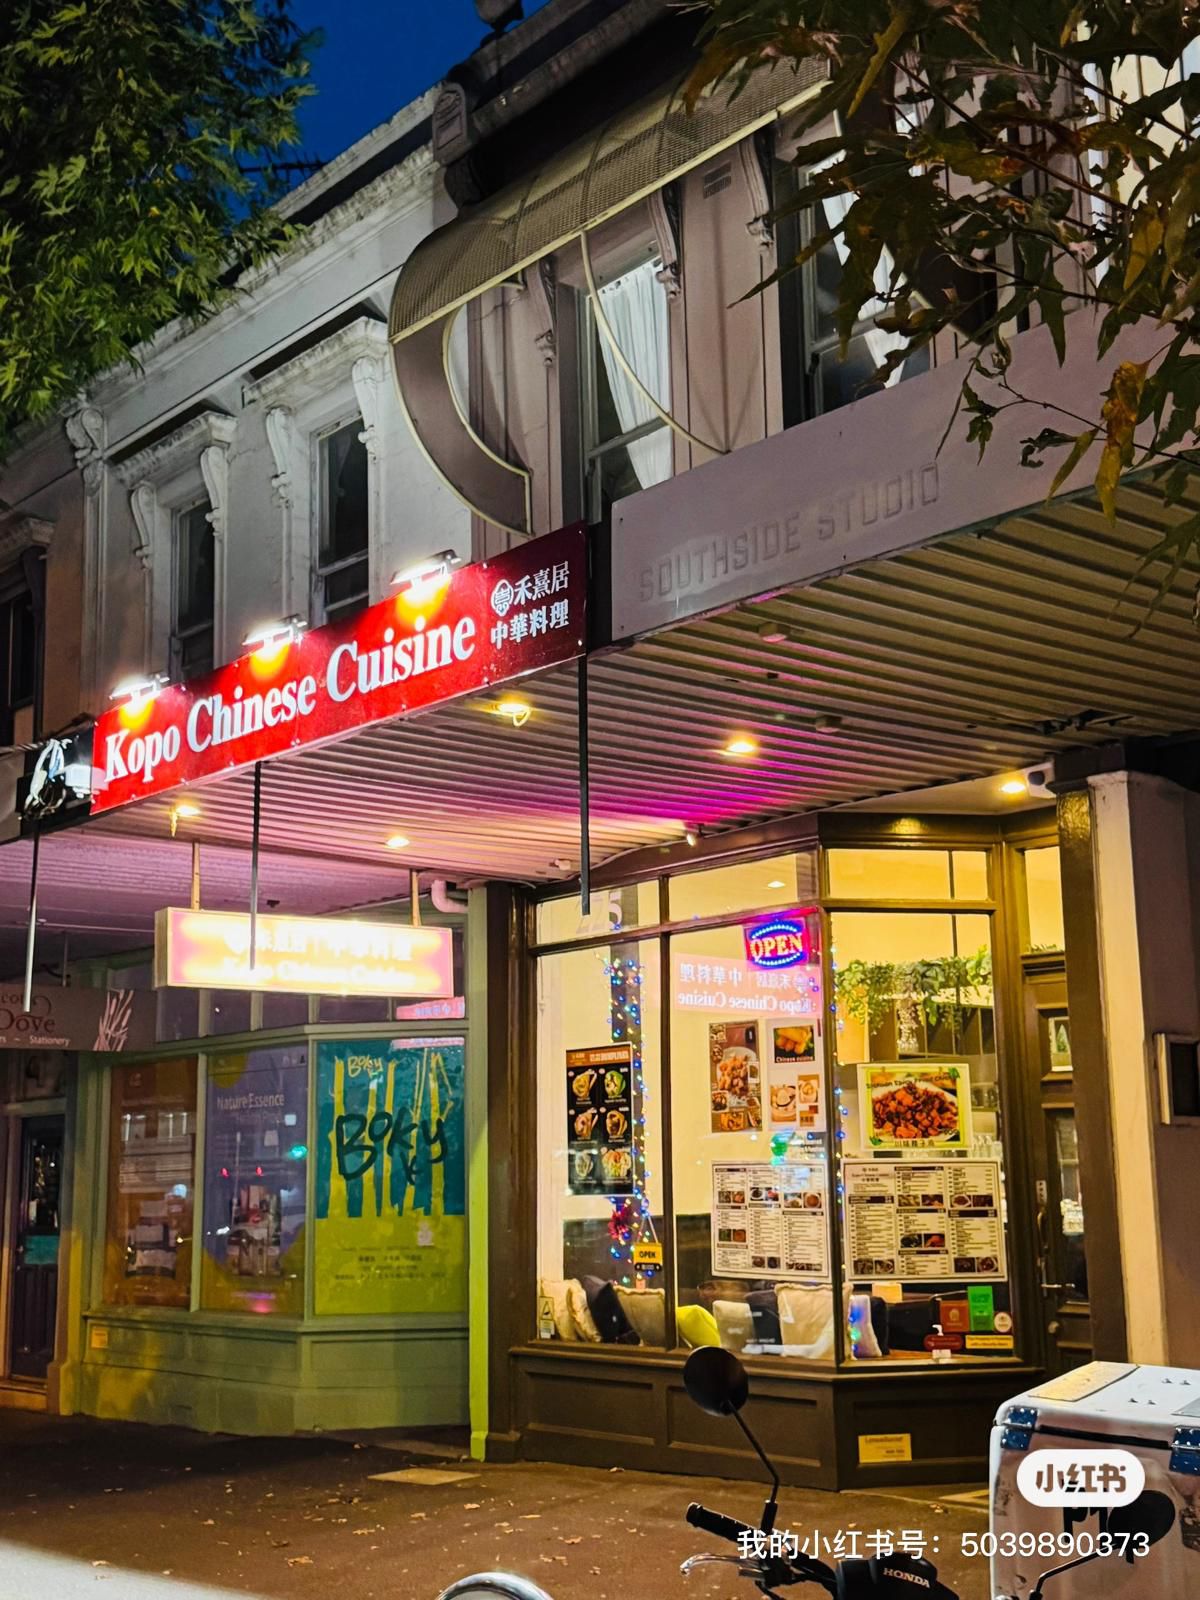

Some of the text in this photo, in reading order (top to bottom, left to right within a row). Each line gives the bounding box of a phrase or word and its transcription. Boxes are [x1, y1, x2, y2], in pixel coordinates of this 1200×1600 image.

[639, 462, 940, 599] SOUTHSIDE STUDIO
[513, 561, 570, 605] 禾熹居
[490, 598, 570, 650] 中華料理
[104, 615, 476, 783] Kopo Chinese Cuisine
[750, 933, 804, 959] OPEN
[883, 1568, 931, 1589] HONDA
